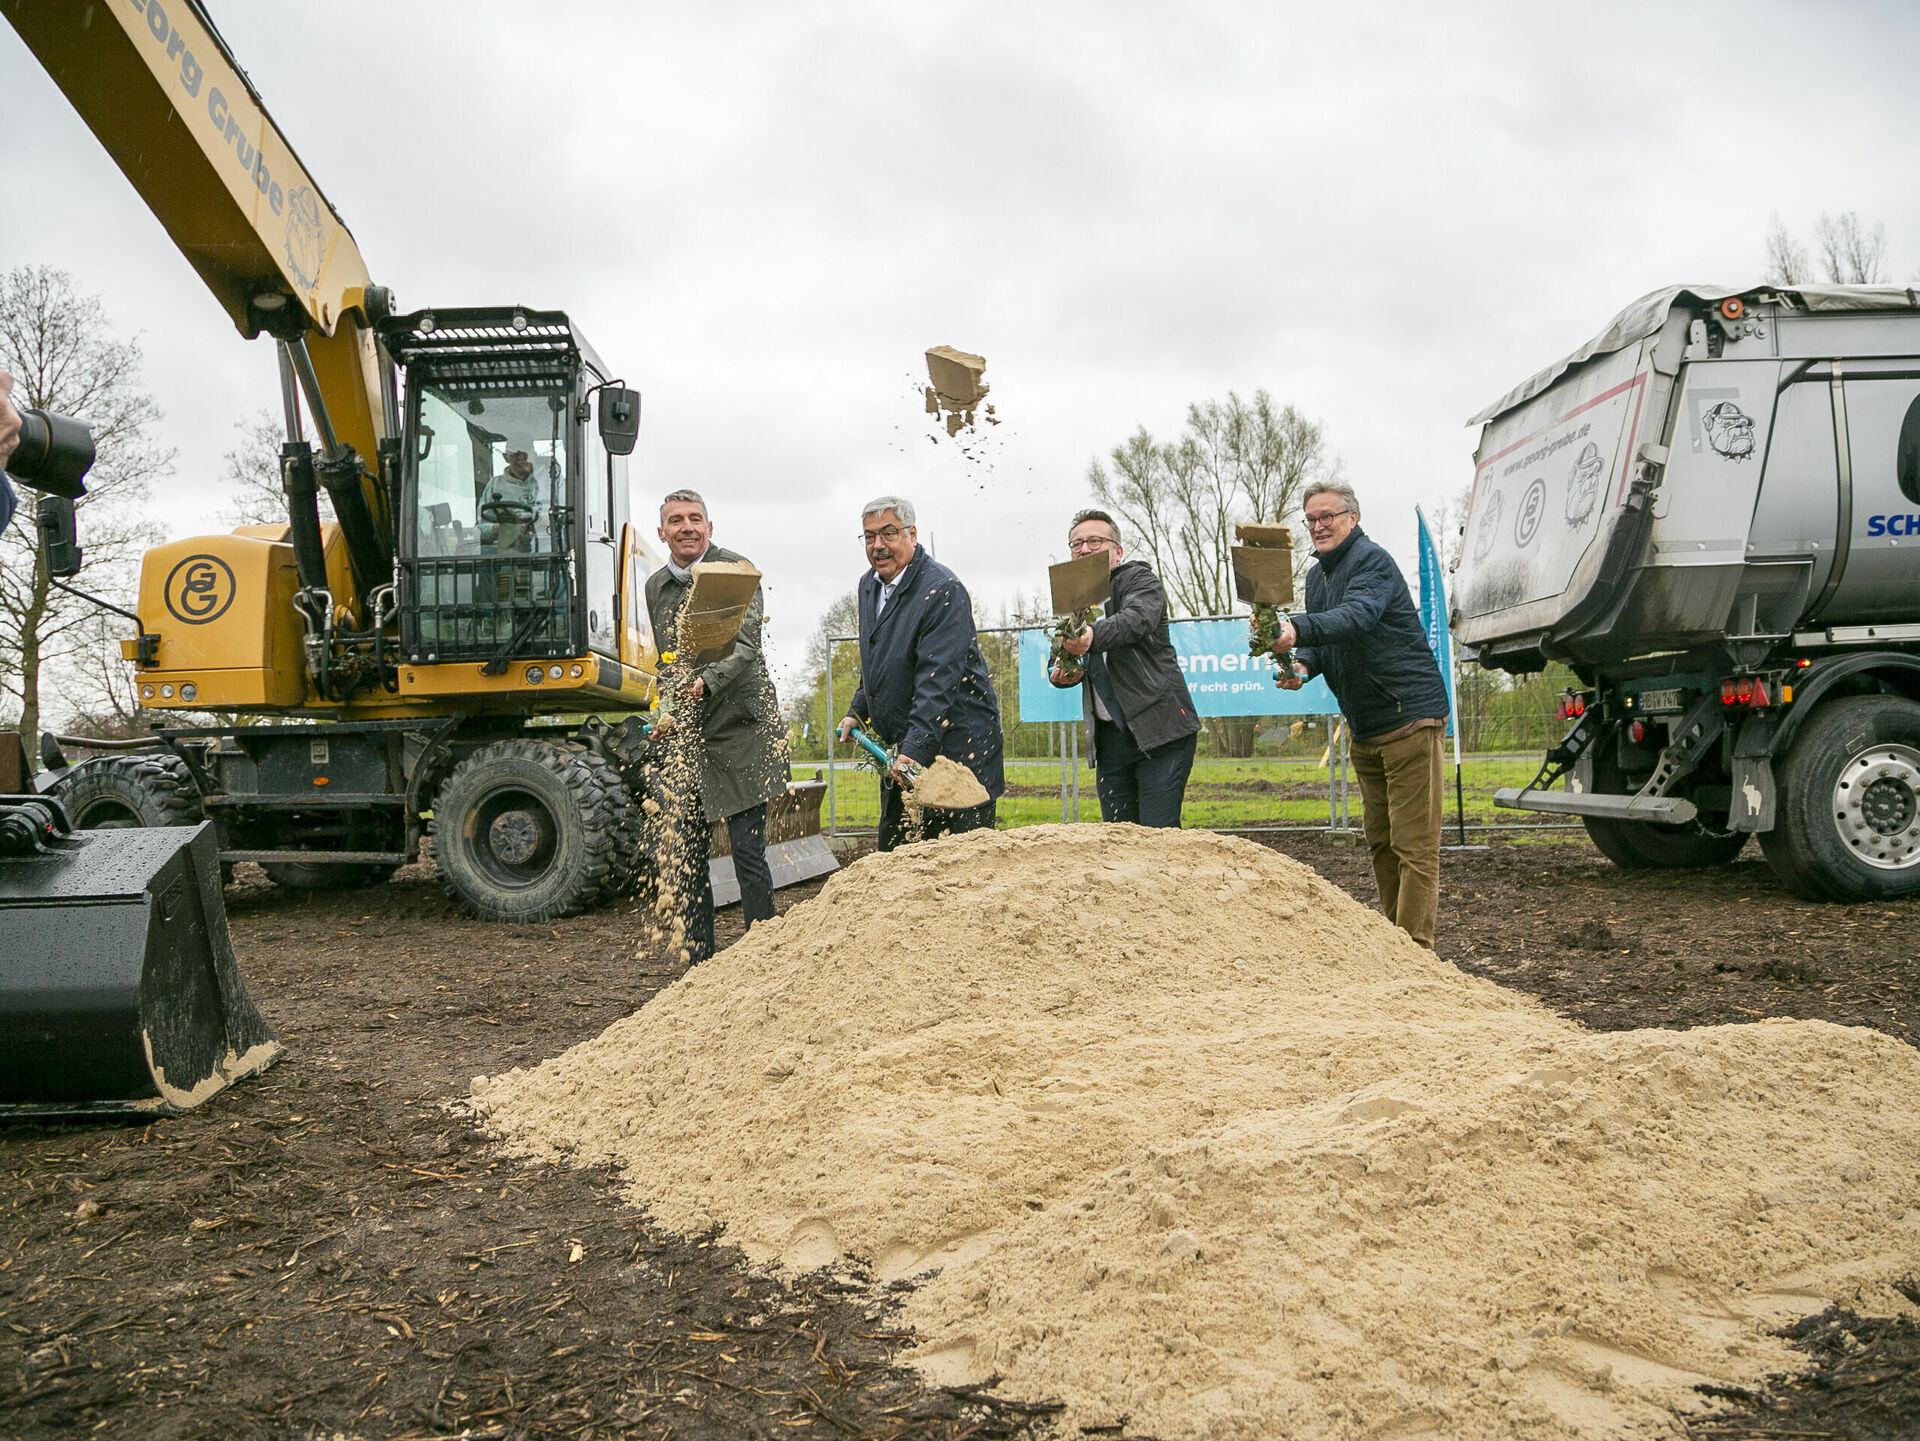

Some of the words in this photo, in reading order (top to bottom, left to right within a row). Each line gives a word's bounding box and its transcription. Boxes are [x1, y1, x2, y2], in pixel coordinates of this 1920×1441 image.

[130, 0, 204, 98] org
[207, 86, 284, 217] Grube
[1503, 422, 1592, 478] www.georg-grube.de
[1867, 514, 1920, 537] SCH
[1427, 546, 1437, 657] emerhaven
[1199, 681, 1228, 692] echt
[1231, 680, 1265, 694] grün.
